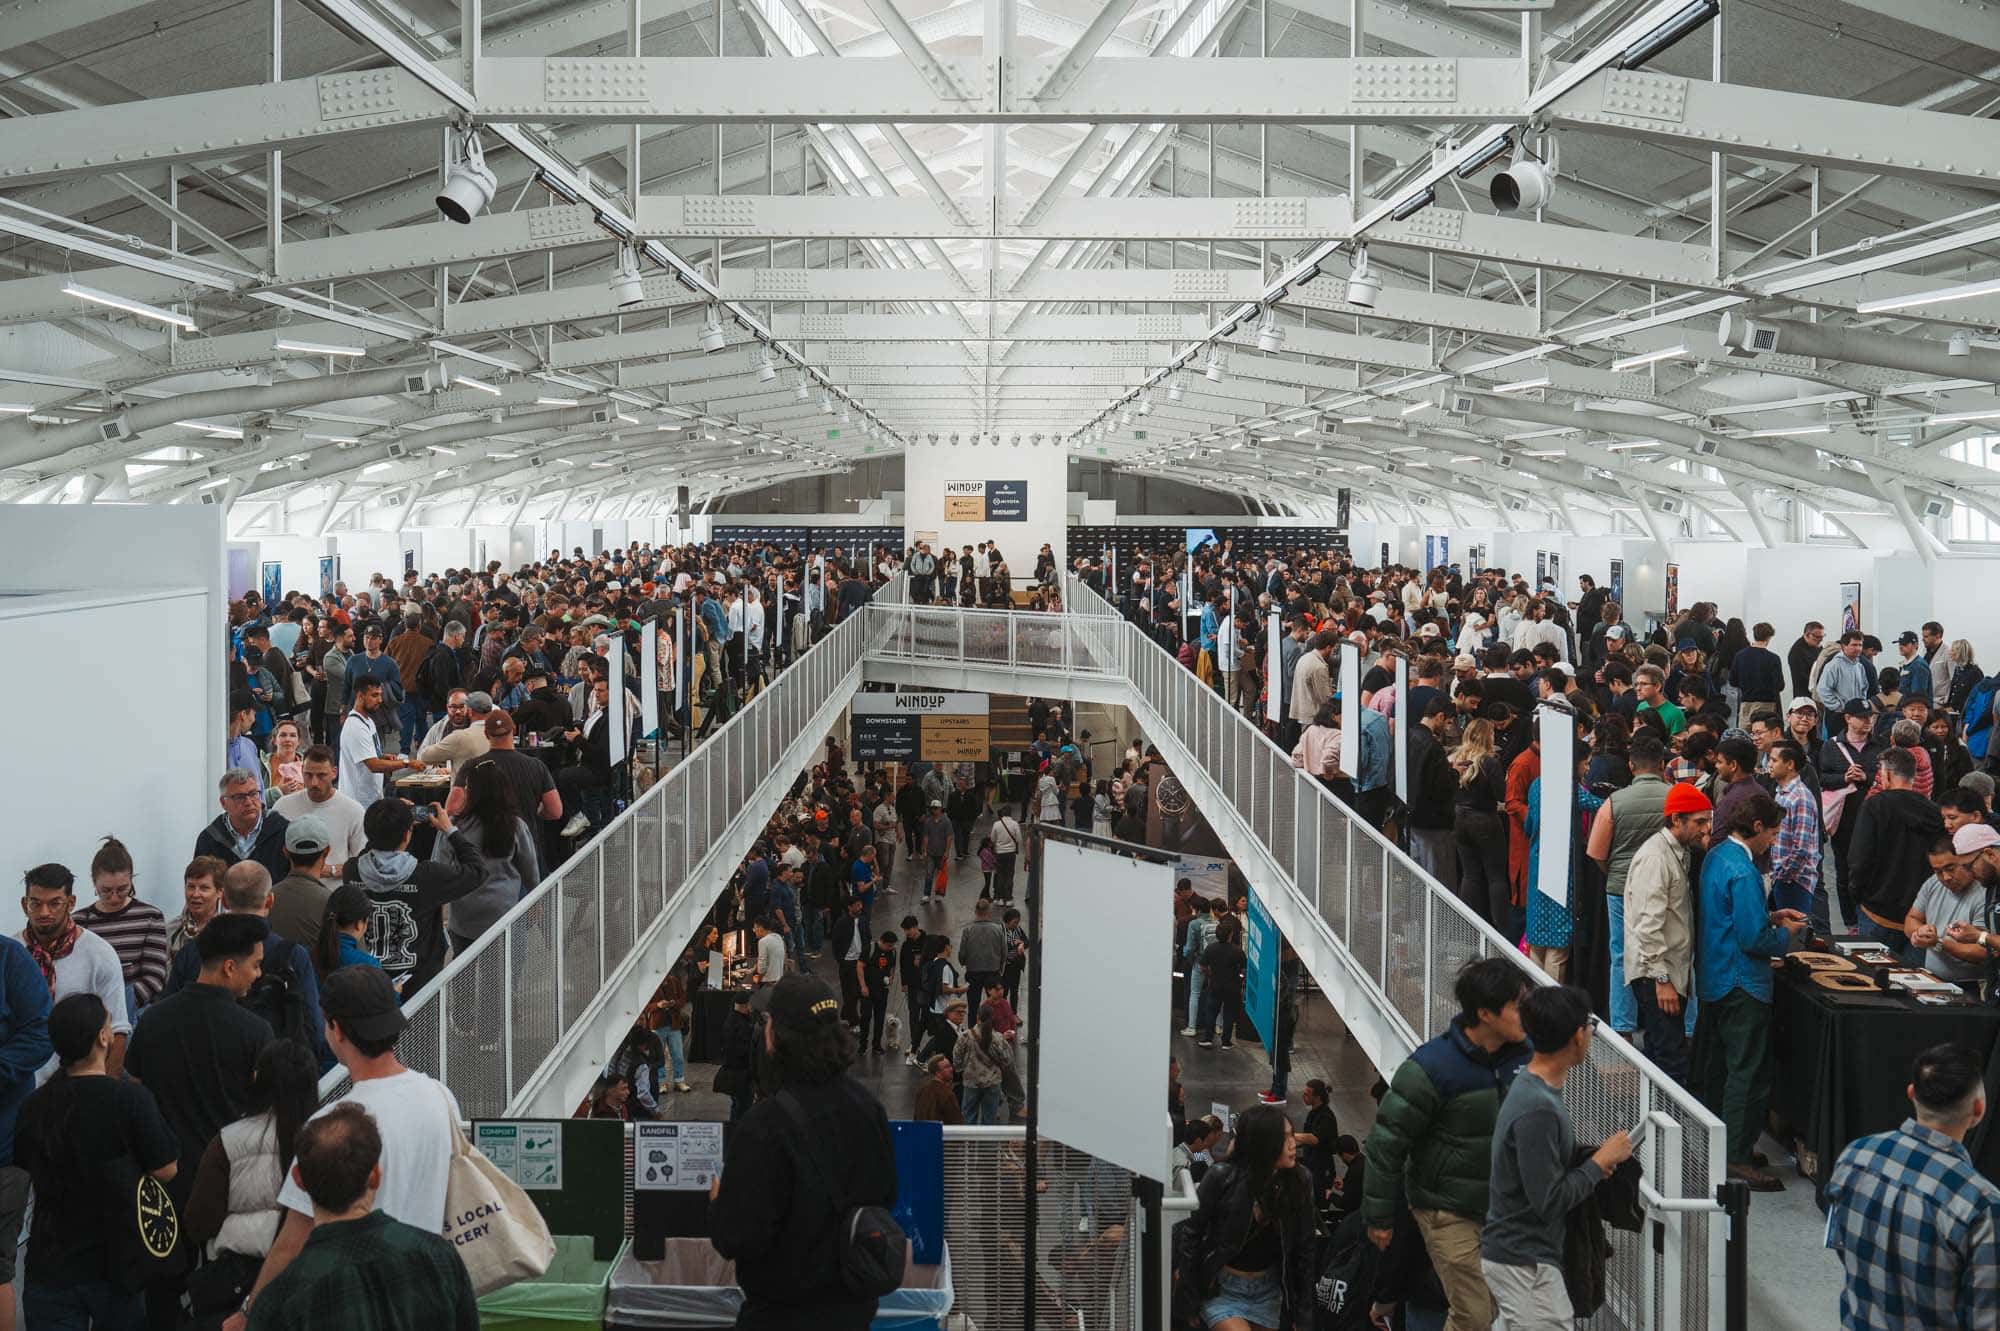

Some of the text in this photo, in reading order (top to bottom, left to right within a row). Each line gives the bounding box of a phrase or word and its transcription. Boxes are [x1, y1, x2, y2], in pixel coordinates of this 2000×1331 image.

[947, 482, 983, 492] WINDUP
[895, 695, 945, 708] WINDUP
[641, 1127, 676, 1135] LANDFILL
[456, 1201, 502, 1226] LOCAL
